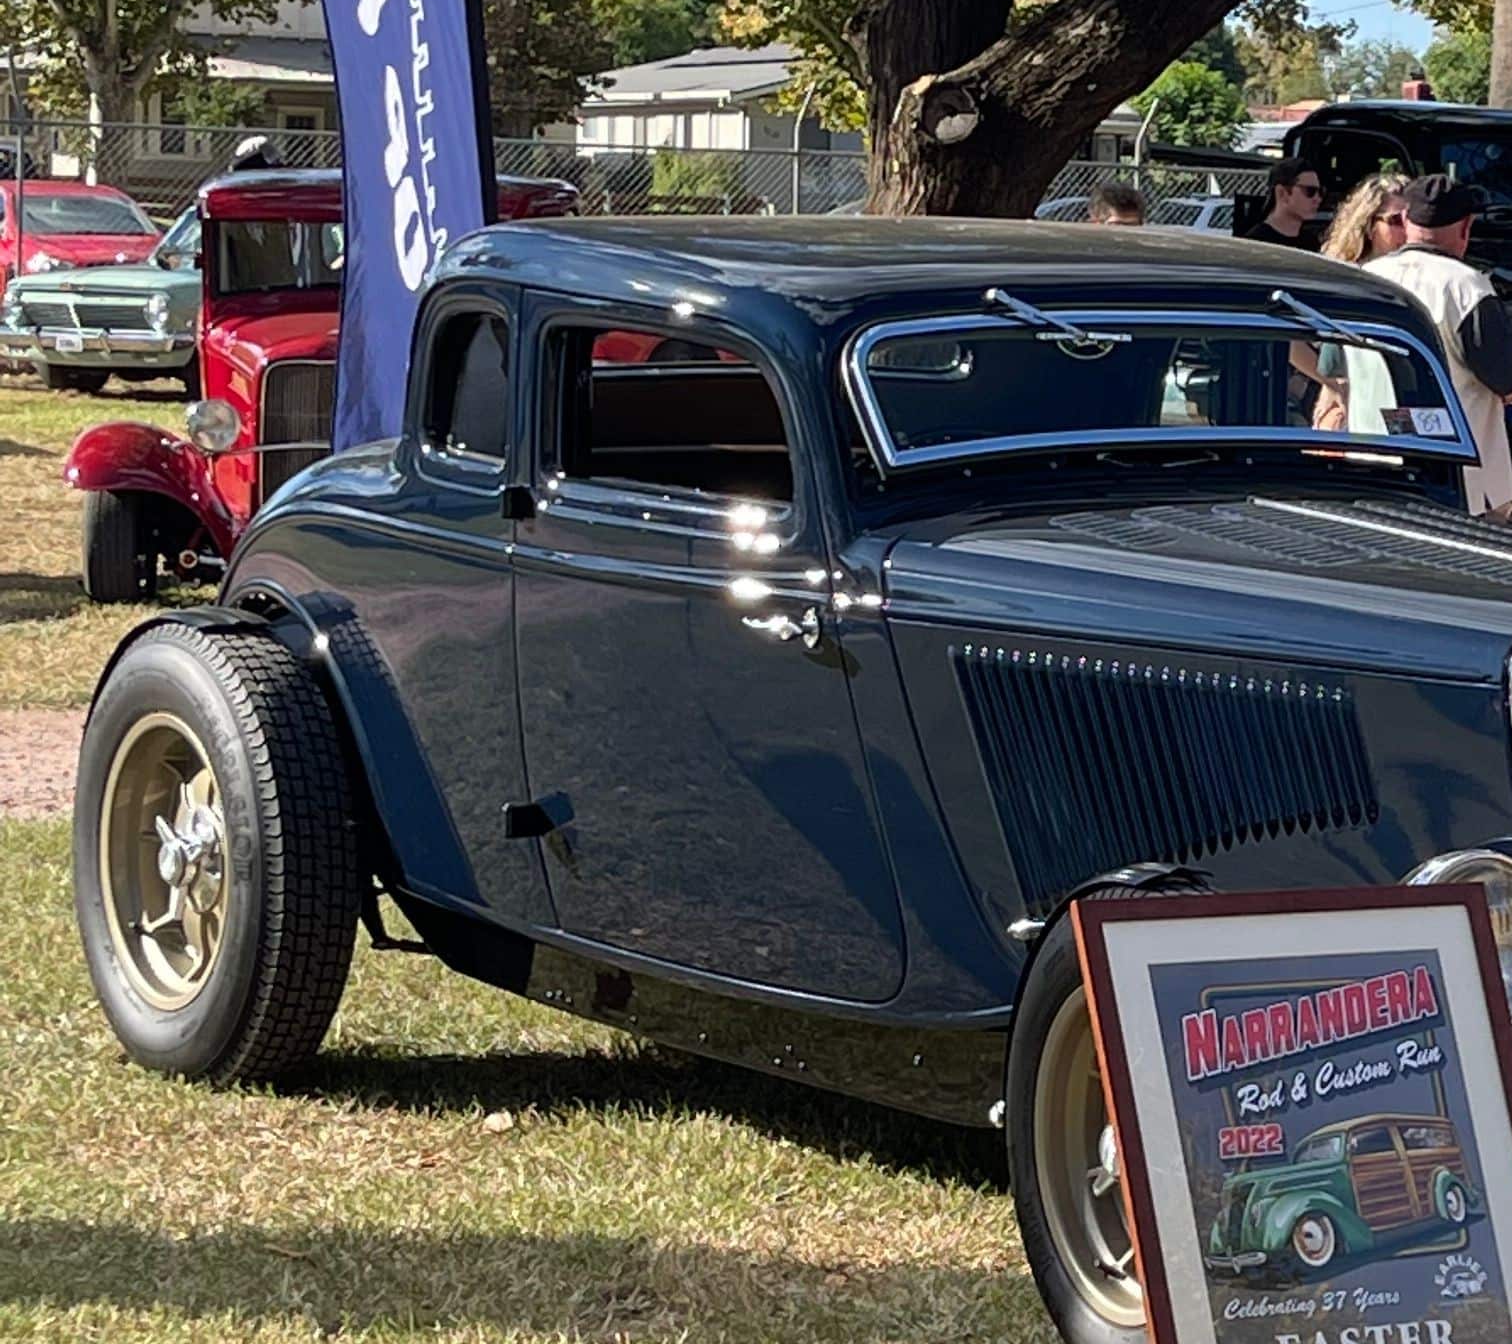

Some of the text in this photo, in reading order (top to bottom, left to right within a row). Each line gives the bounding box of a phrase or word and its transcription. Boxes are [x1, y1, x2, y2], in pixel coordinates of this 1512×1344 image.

[1182, 965, 1439, 1081] NARRANDERA
[1237, 1039, 1442, 1117] Rod & Custom Run
[1218, 1123, 1284, 1159] 2022
[1223, 1287, 1401, 1321] Celebrating 37 Years
